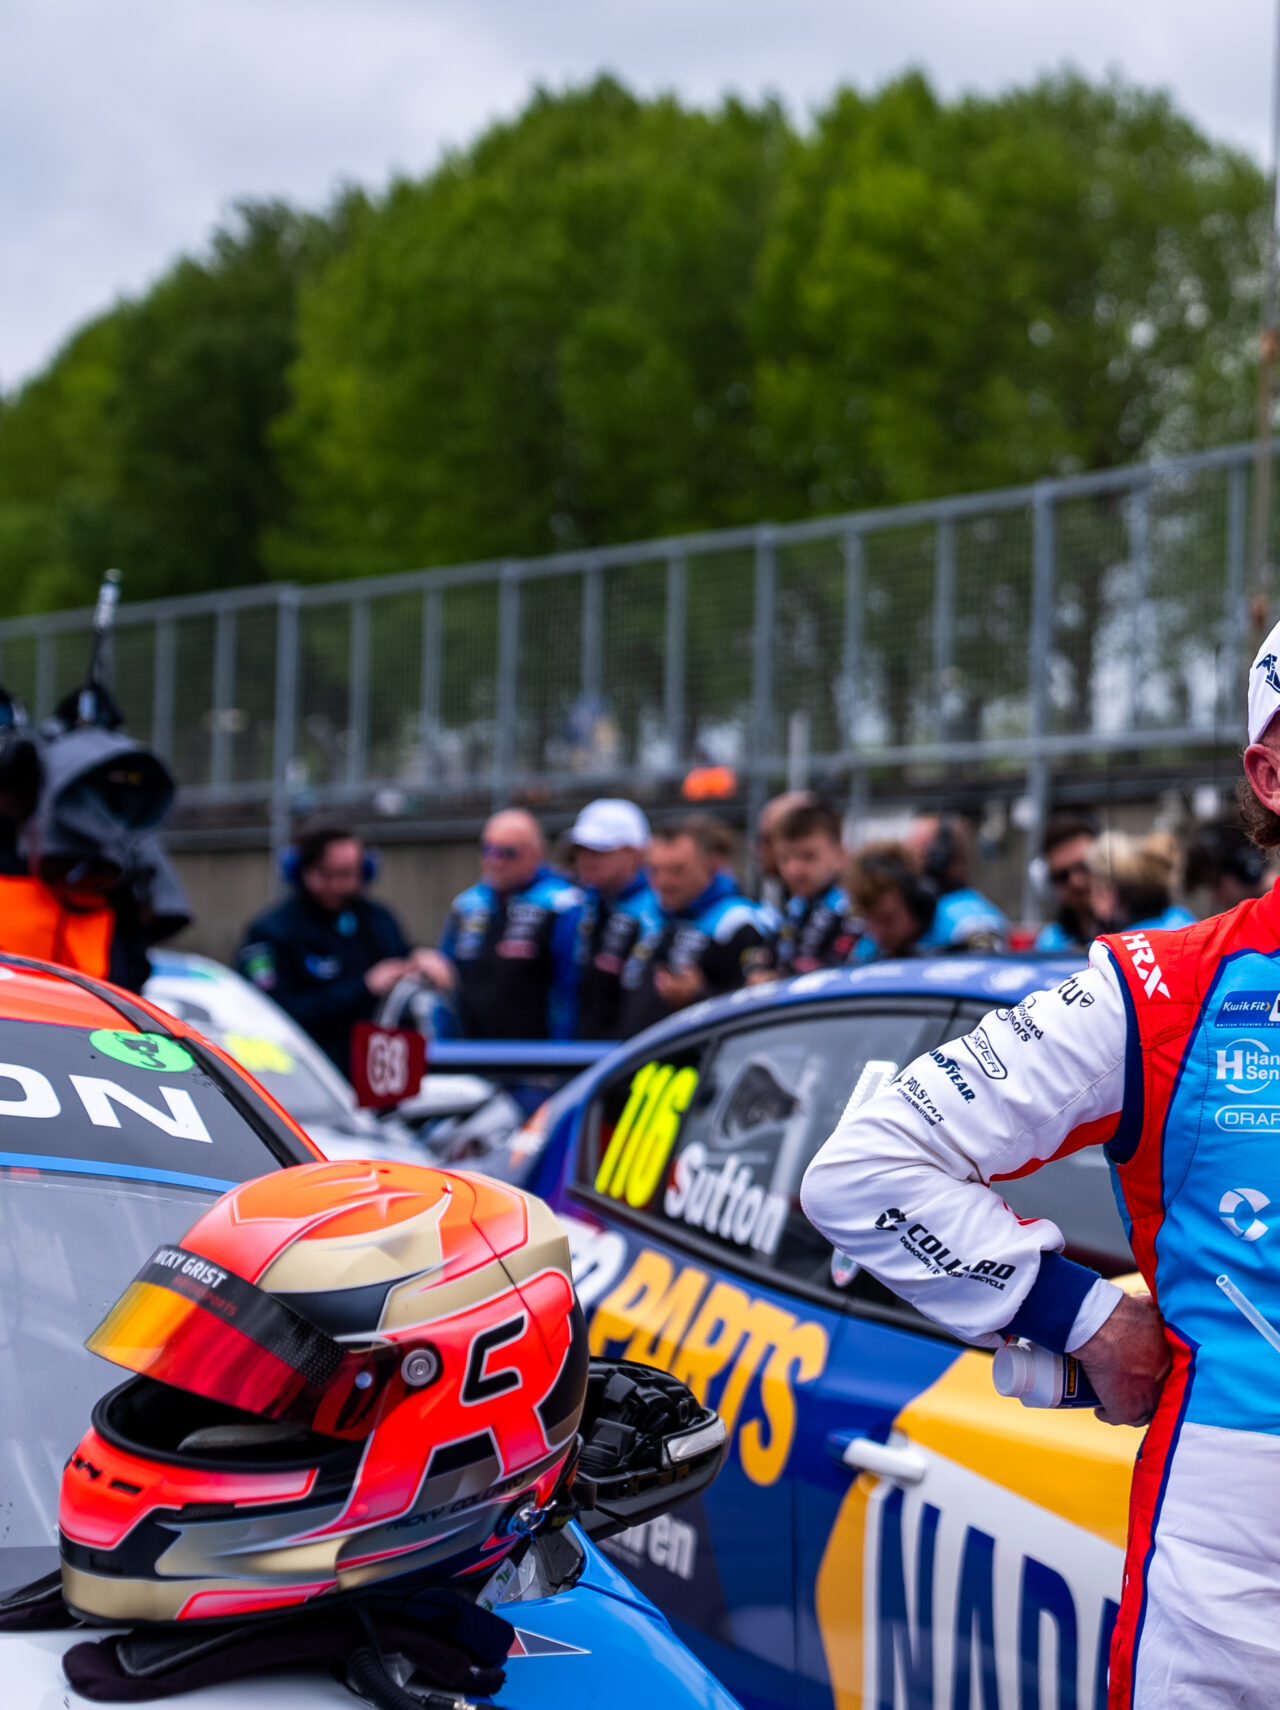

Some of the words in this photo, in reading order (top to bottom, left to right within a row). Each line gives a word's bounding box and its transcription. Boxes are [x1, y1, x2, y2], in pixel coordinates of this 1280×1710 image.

[1121, 933, 1171, 999] HRX
[594, 1060, 699, 1208] 116
[664, 1141, 789, 1256] Sutton
[181, 1257, 228, 1289] GRIST
[588, 1248, 829, 1487] PARTS
